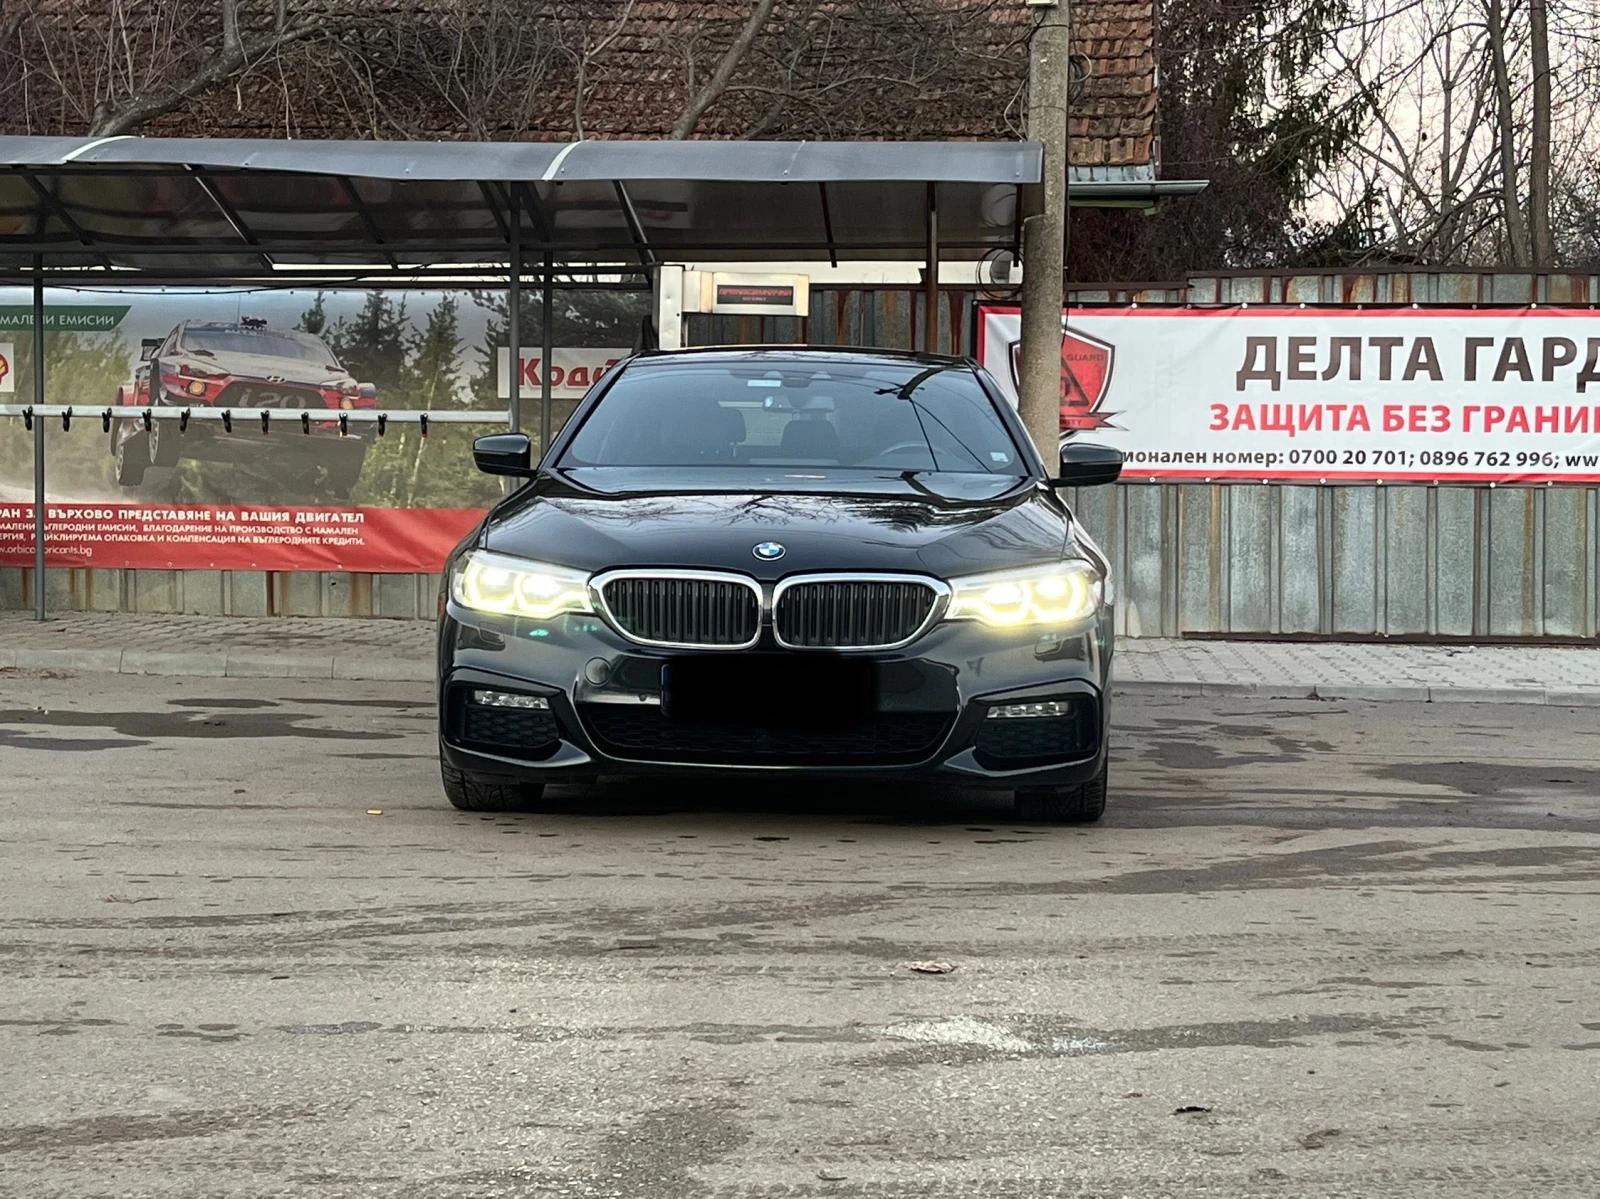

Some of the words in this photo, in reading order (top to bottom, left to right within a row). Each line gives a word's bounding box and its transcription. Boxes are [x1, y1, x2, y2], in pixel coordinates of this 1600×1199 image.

[0, 315, 54, 325] МАЛЕИ
[60, 315, 114, 325] ЕМИСИИ
[1236, 336, 1443, 391] ДЕЛТА
[1209, 403, 1371, 437] ЗАЩИТА
[1382, 404, 1451, 432] БЕЗ
[1462, 406, 1600, 433] ГРАНИ
[1213, 452, 1284, 467] номер:
[1289, 450, 1337, 464] 0700
[1343, 450, 1366, 464] 20
[1372, 451, 1415, 467] 701;
[1420, 451, 1468, 466] 0896
[1474, 452, 1510, 466] 762
[1516, 452, 1560, 469] 996;
[26, 508, 36, 518] З
[48, 509, 113, 519] ВЪРХОВО
[118, 509, 210, 521] ПРЕДСТАВЯНЕ
[216, 511, 236, 521] НА
[241, 511, 290, 521] ВАШИЯ
[294, 512, 364, 523] ДВИГАТЕЛ
[44, 523, 95, 532] ЪГЛЕРОДНИ
[97, 524, 138, 533] ЕМИСИИ,
[143, 524, 212, 533] БЛАГОДАРЕНИЕ
[214, 525, 228, 533] НА
[229, 525, 303, 535] ПРОИЗВОДСТВО
[31, 533, 103, 542] РИКЛИРУЕМА
[104, 534, 155, 542] ОПАКОВКА
[166, 535, 236, 544] КОМПЕНСАЦИЯ
[253, 536, 320, 545] ВЪГЛЕРОДНИТЕ
[322, 537, 365, 546] КРЕДИТИ.
